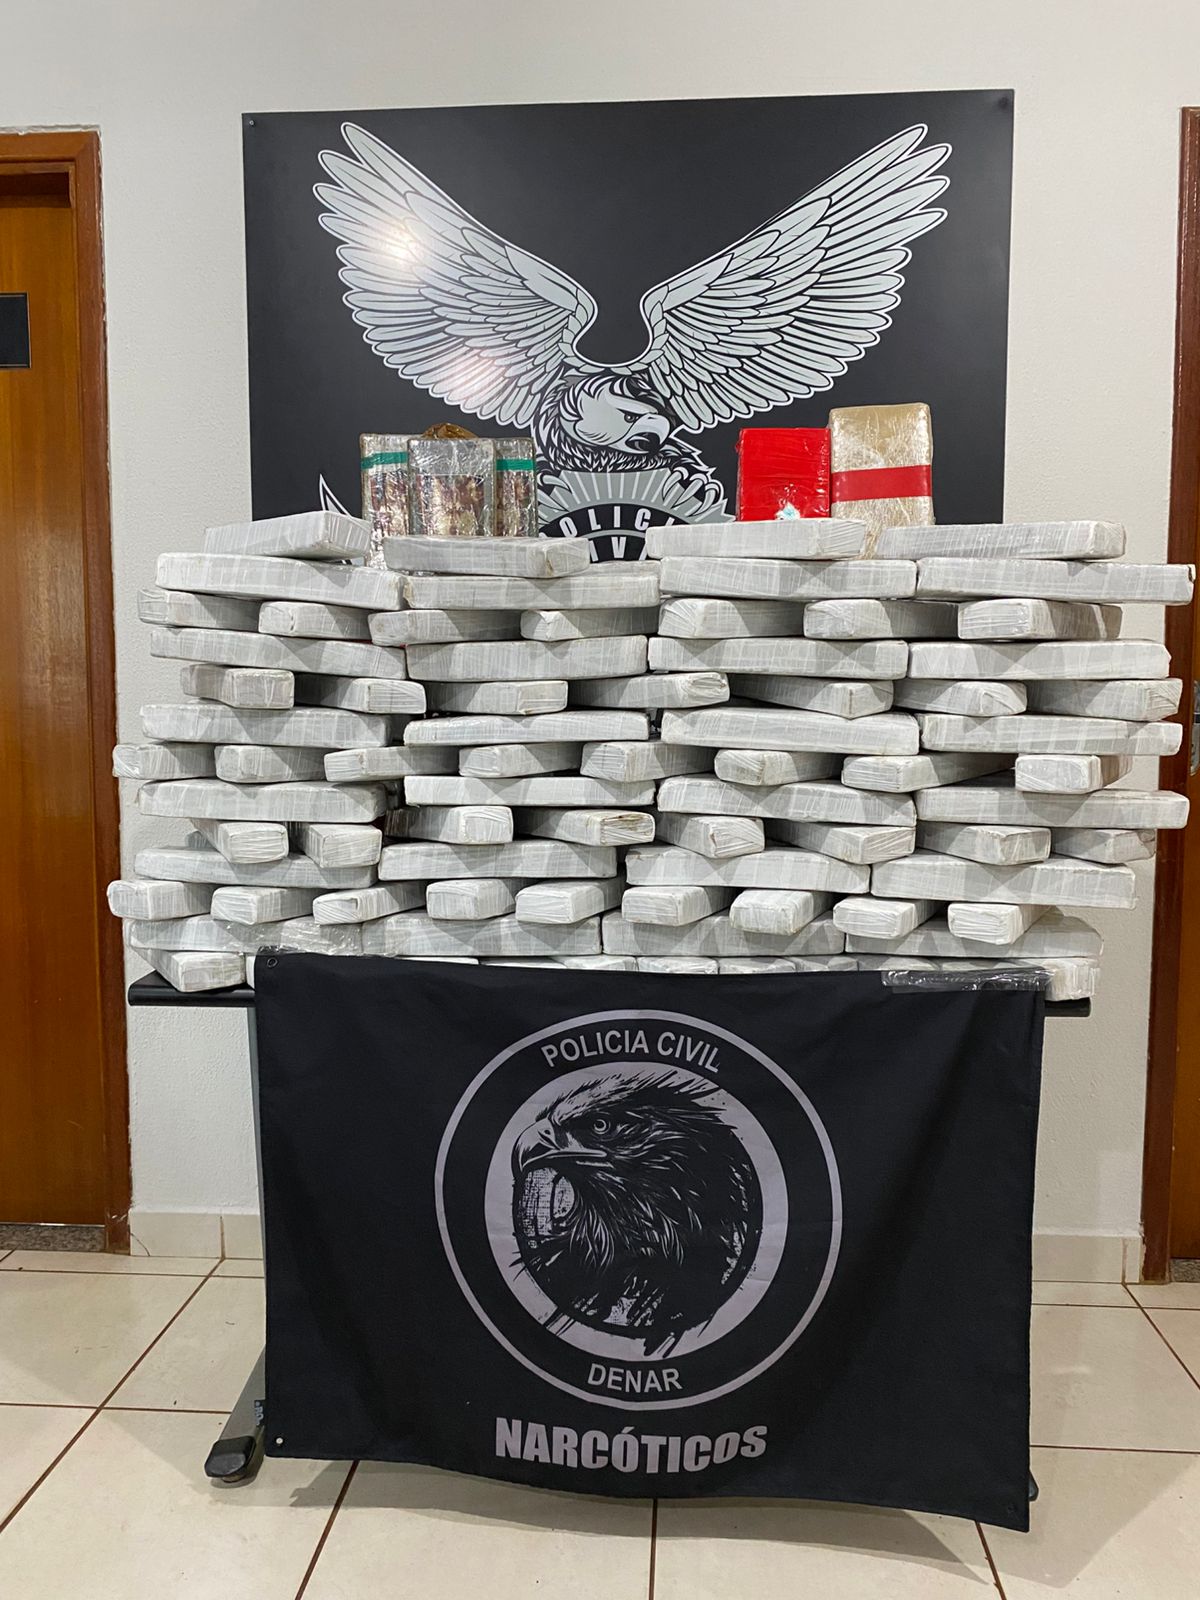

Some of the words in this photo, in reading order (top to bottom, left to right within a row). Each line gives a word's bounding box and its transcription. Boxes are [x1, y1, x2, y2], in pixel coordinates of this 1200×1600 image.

[540, 505, 675, 539] OLIC
[541, 1030, 649, 1067] POLICIA
[657, 1031, 719, 1073] CIVIL
[587, 1363, 683, 1393] DENAR
[495, 1417, 768, 1473] NARCÓTICOS
